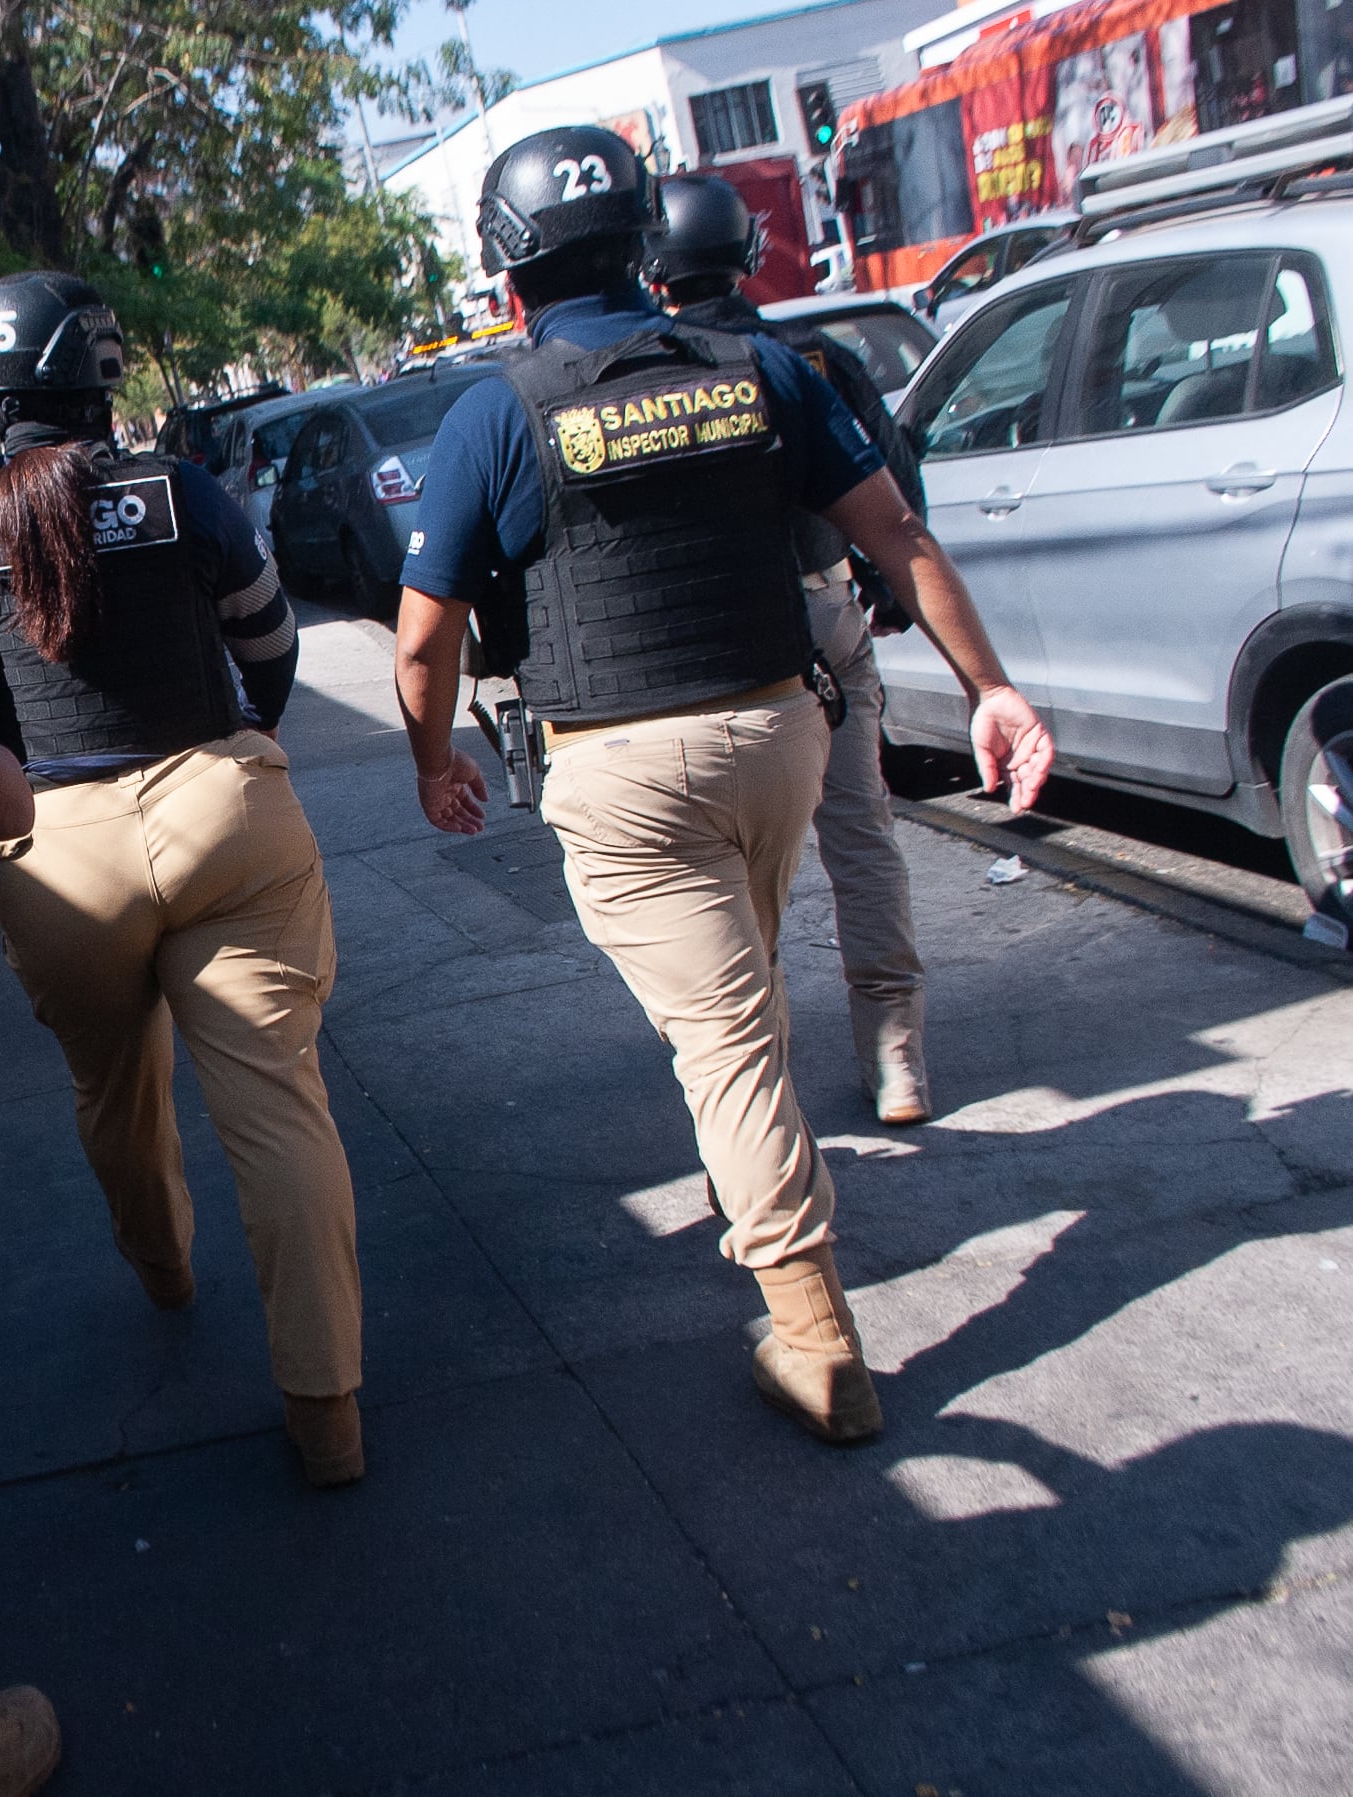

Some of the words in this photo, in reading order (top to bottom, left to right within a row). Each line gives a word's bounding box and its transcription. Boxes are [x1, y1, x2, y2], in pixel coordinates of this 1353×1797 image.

[553, 154, 612, 202] 23
[600, 380, 759, 431] SANTIAGO
[606, 424, 690, 462] INSPECTOR
[695, 411, 769, 443] MUNICIPAL
[90, 494, 147, 531] GO
[93, 527, 138, 545] RIDAD
